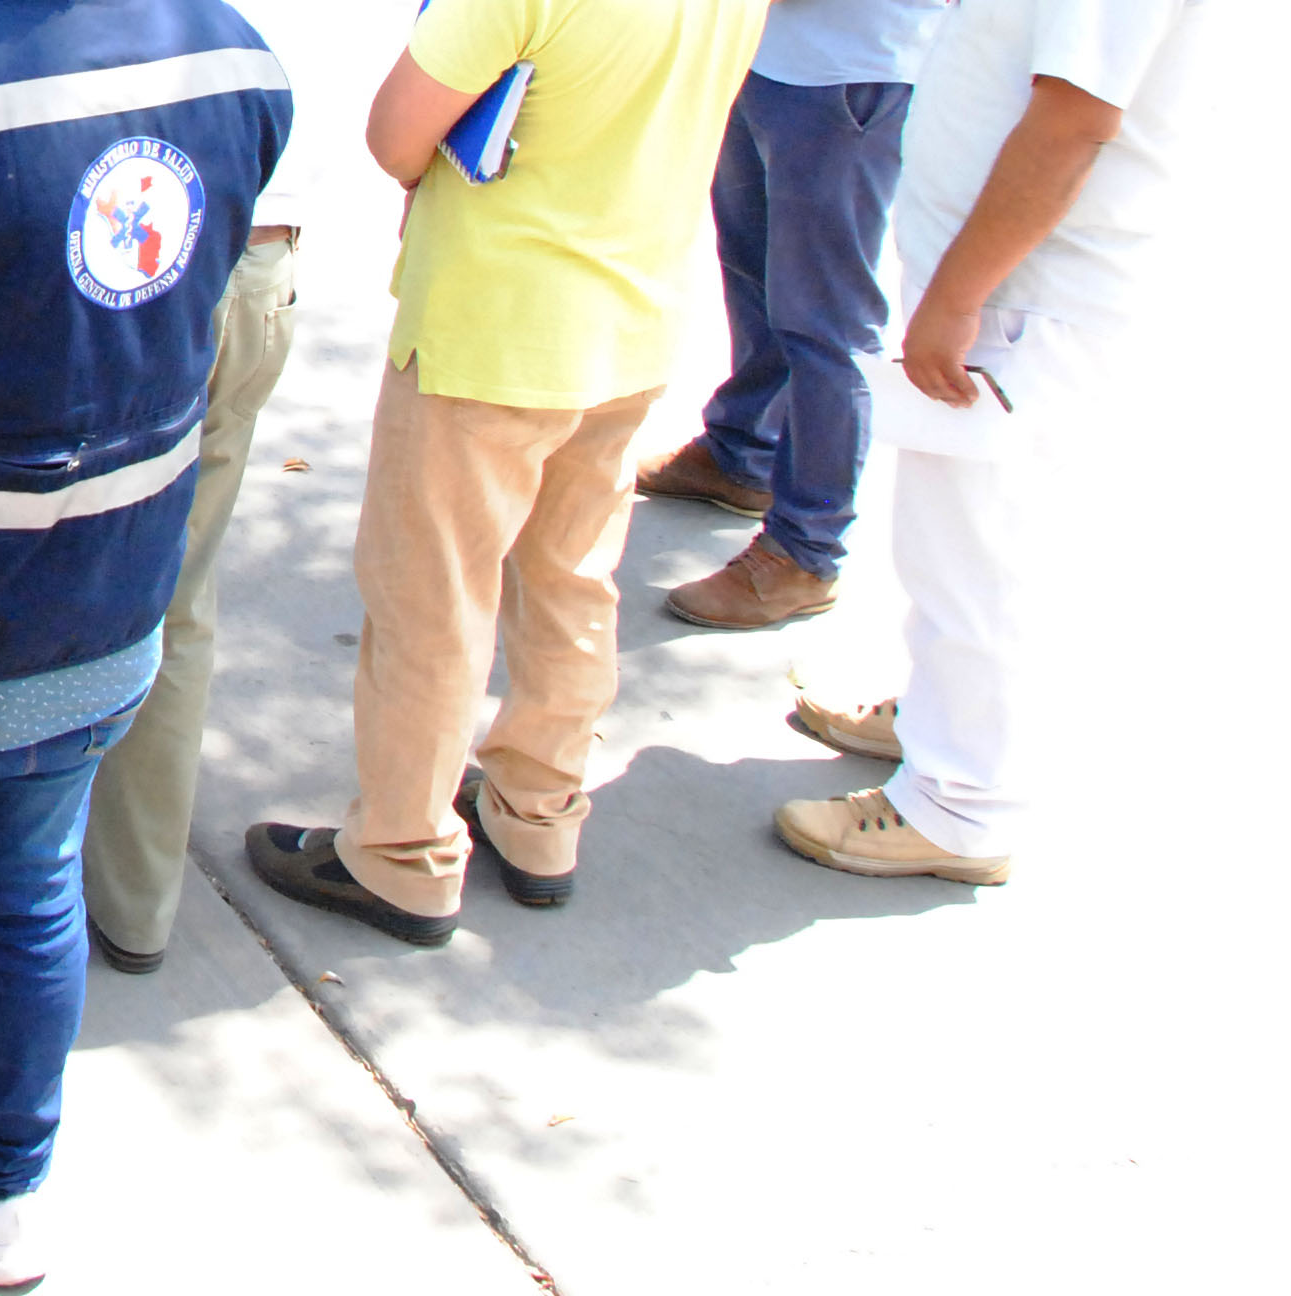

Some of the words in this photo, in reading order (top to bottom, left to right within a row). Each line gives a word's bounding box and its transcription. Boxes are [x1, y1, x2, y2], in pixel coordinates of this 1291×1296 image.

[81, 141, 139, 198] MINISTERIO
[143, 140, 161, 158] DE
[163, 148, 195, 184] SALUD
[70, 230, 84, 280] OFICINA
[78, 272, 117, 306] GENERAL
[135, 267, 179, 303] DEFENSA
[176, 208, 202, 268] NACIONAL
